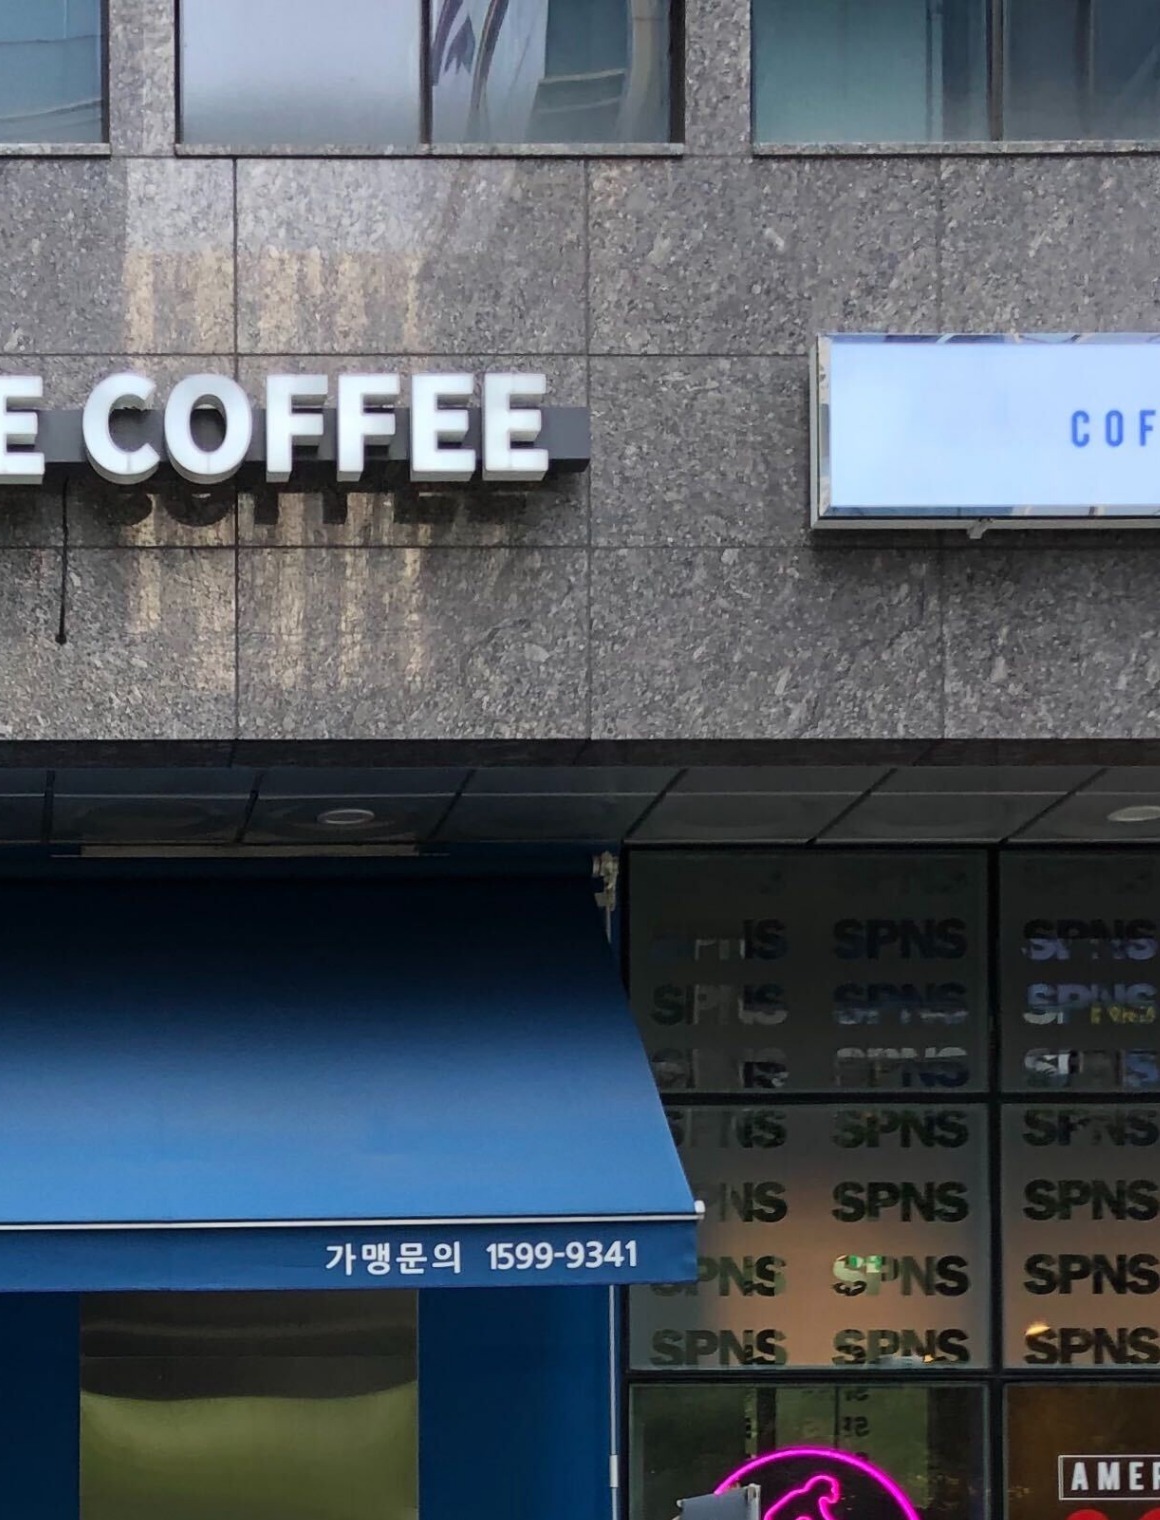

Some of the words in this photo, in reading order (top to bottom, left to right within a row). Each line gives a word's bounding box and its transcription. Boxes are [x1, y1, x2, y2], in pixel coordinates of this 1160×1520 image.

[82, 372, 550, 485] COFFEE
[1071, 410, 1157, 448] COF
[834, 917, 967, 960] SPNS
[833, 1110, 969, 1149] SPNS
[832, 1181, 969, 1222] SPNS
[1023, 1179, 1159, 1221] SPNS
[325, 1241, 462, 1276] 가맹문의
[485, 1240, 638, 1270] 1599-9341
[831, 1254, 971, 1297] SPNS
[1023, 1254, 1160, 1295] SPNS
[651, 1329, 787, 1366] SPNS
[832, 1329, 970, 1366] SPNS
[1024, 1327, 1160, 1364] SPNS
[1071, 1461, 1160, 1491] AME
